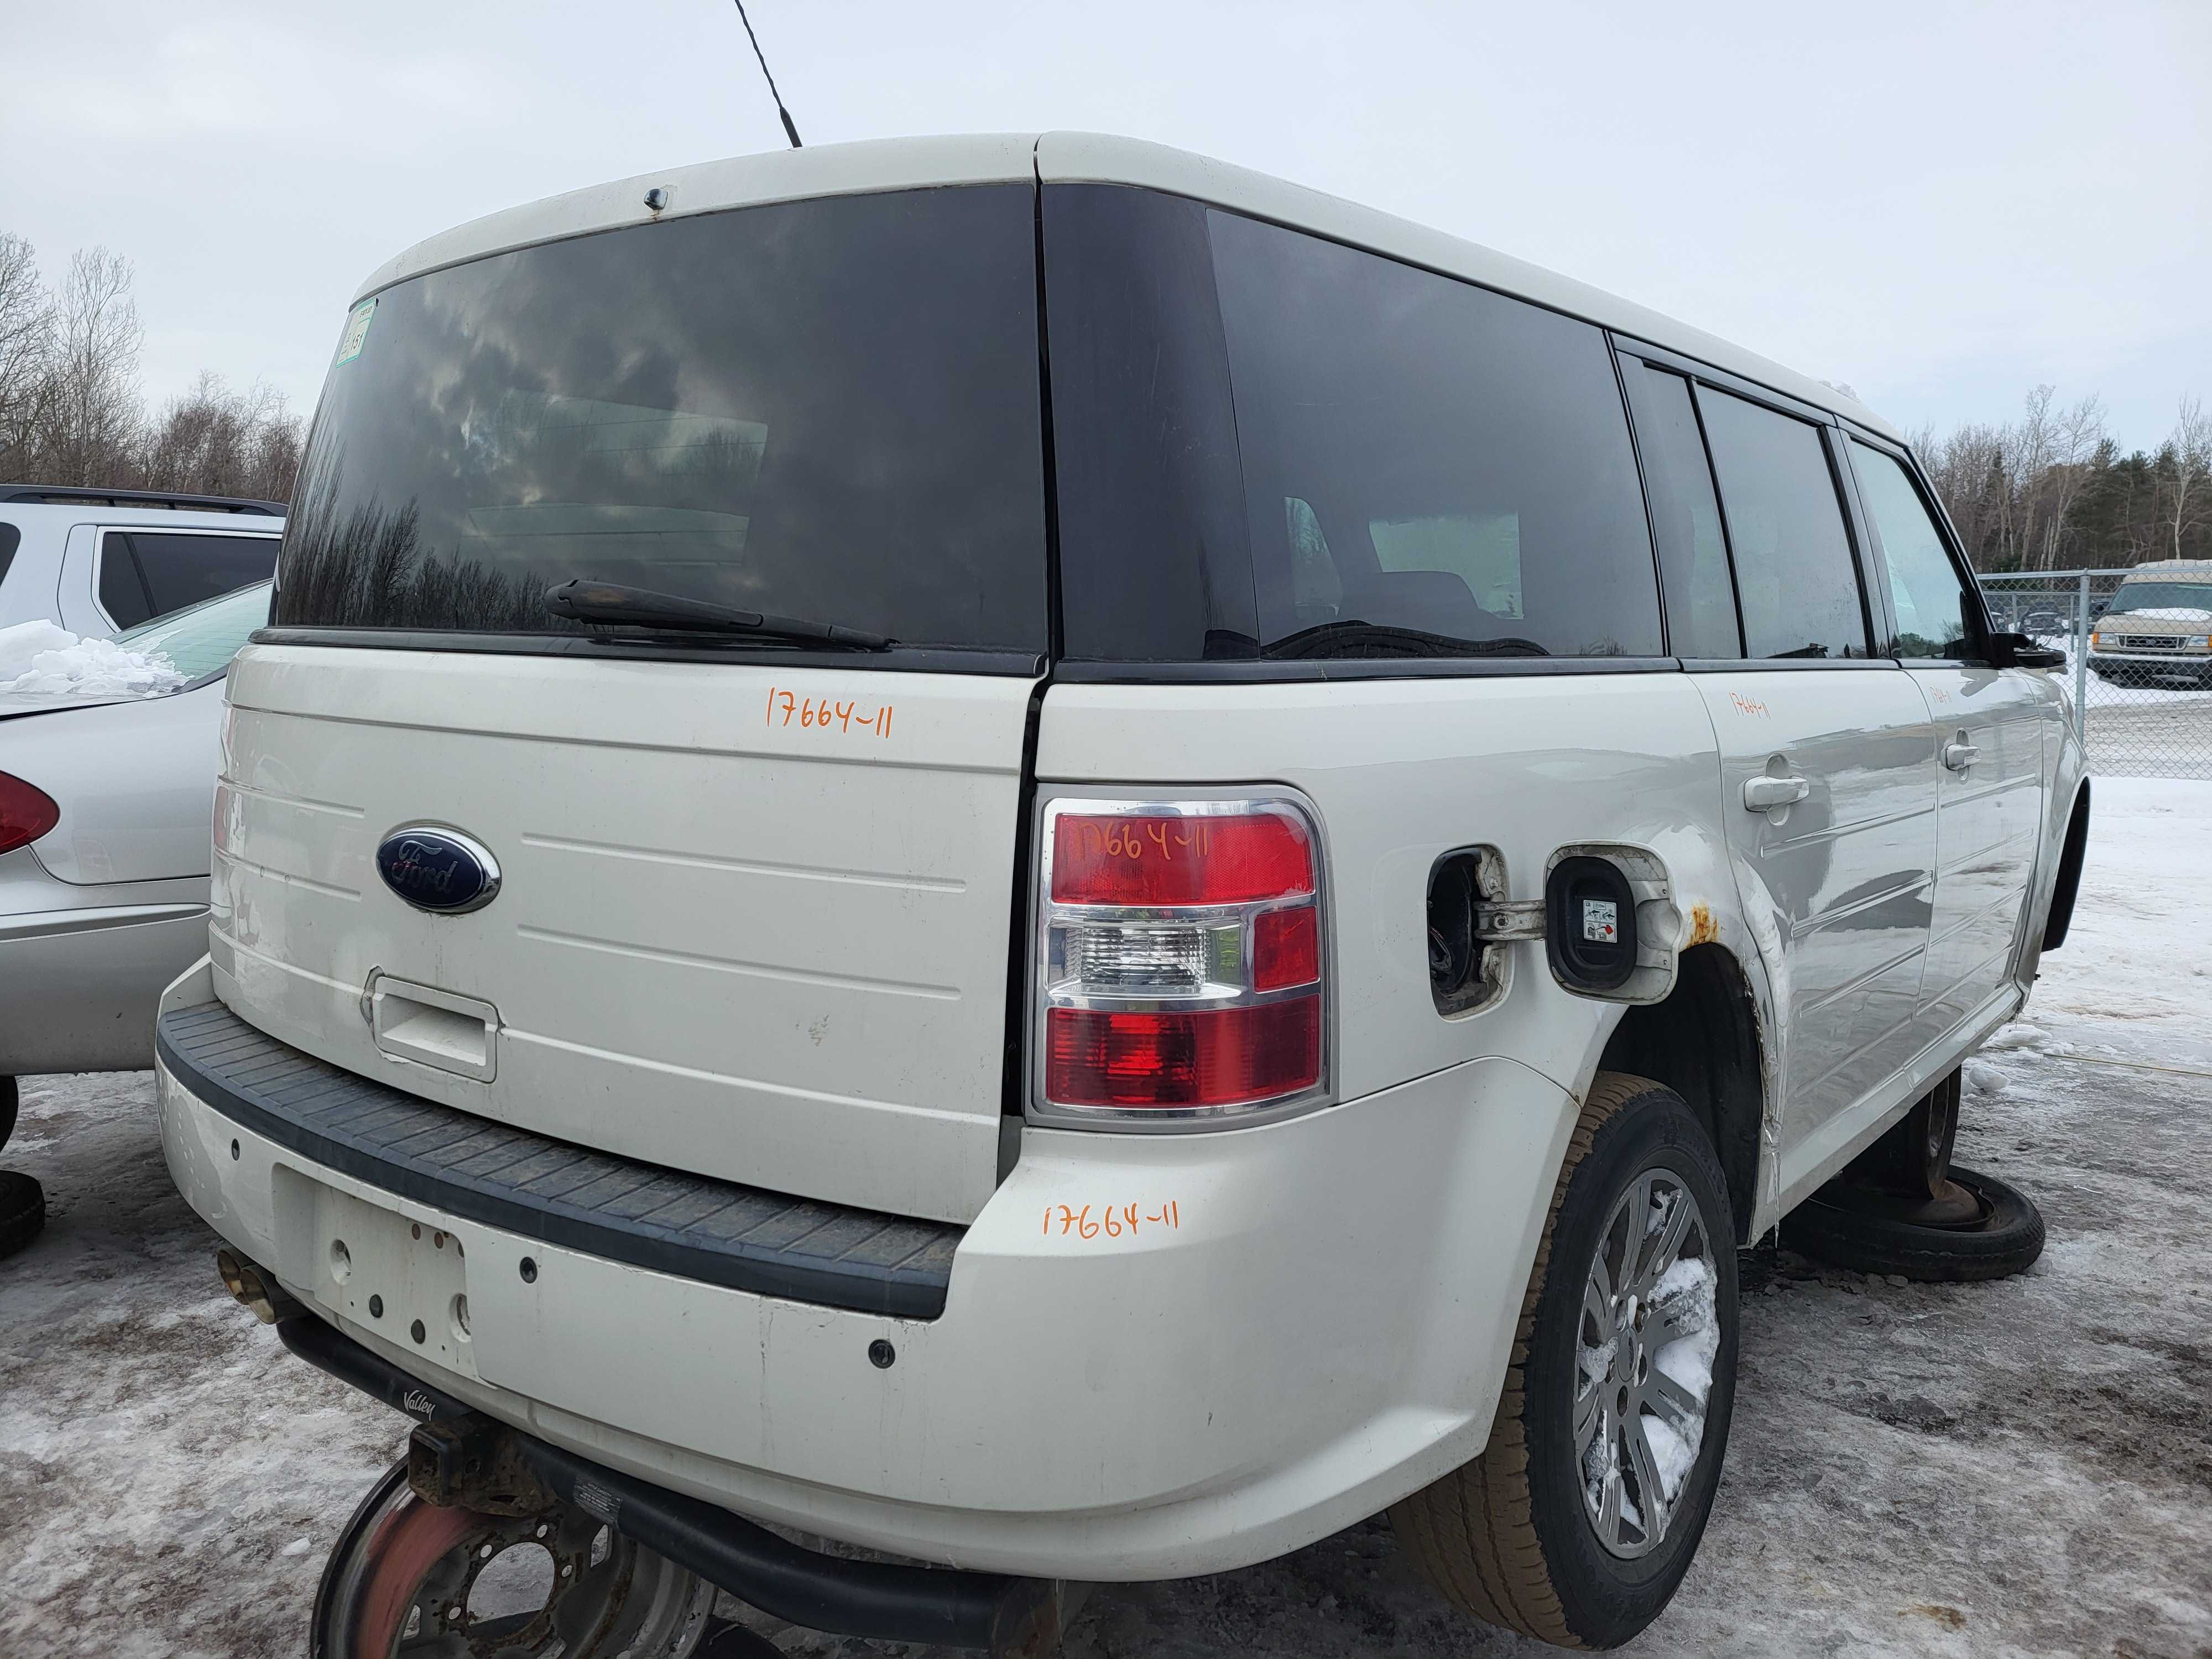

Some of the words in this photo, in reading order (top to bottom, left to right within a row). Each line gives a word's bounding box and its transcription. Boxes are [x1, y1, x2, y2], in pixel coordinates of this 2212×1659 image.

[766, 686, 894, 739] 17664-11
[1729, 692, 1771, 720] 17664-11
[391, 839, 459, 894] Ford
[1043, 1199, 1179, 1239] 17664-11
[404, 1389, 436, 1422] Valley
